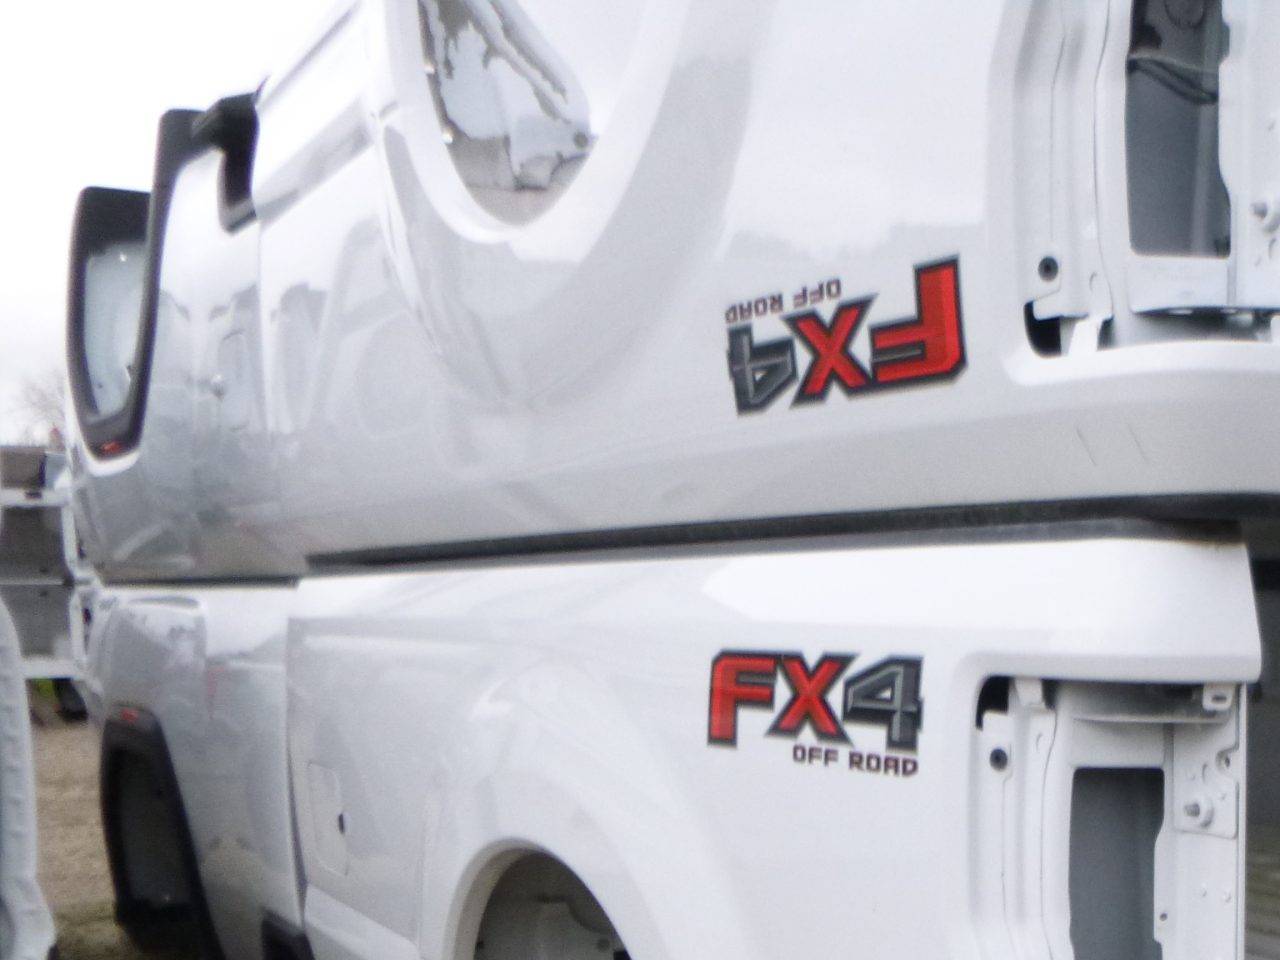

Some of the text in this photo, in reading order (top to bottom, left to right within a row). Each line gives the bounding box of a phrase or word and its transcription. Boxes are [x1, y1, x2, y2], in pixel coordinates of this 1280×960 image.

[725, 278, 842, 324] OFF ROAD
[727, 253, 968, 417] FX4
[707, 648, 924, 753] FX4
[793, 745, 919, 777] OFF ROAD
